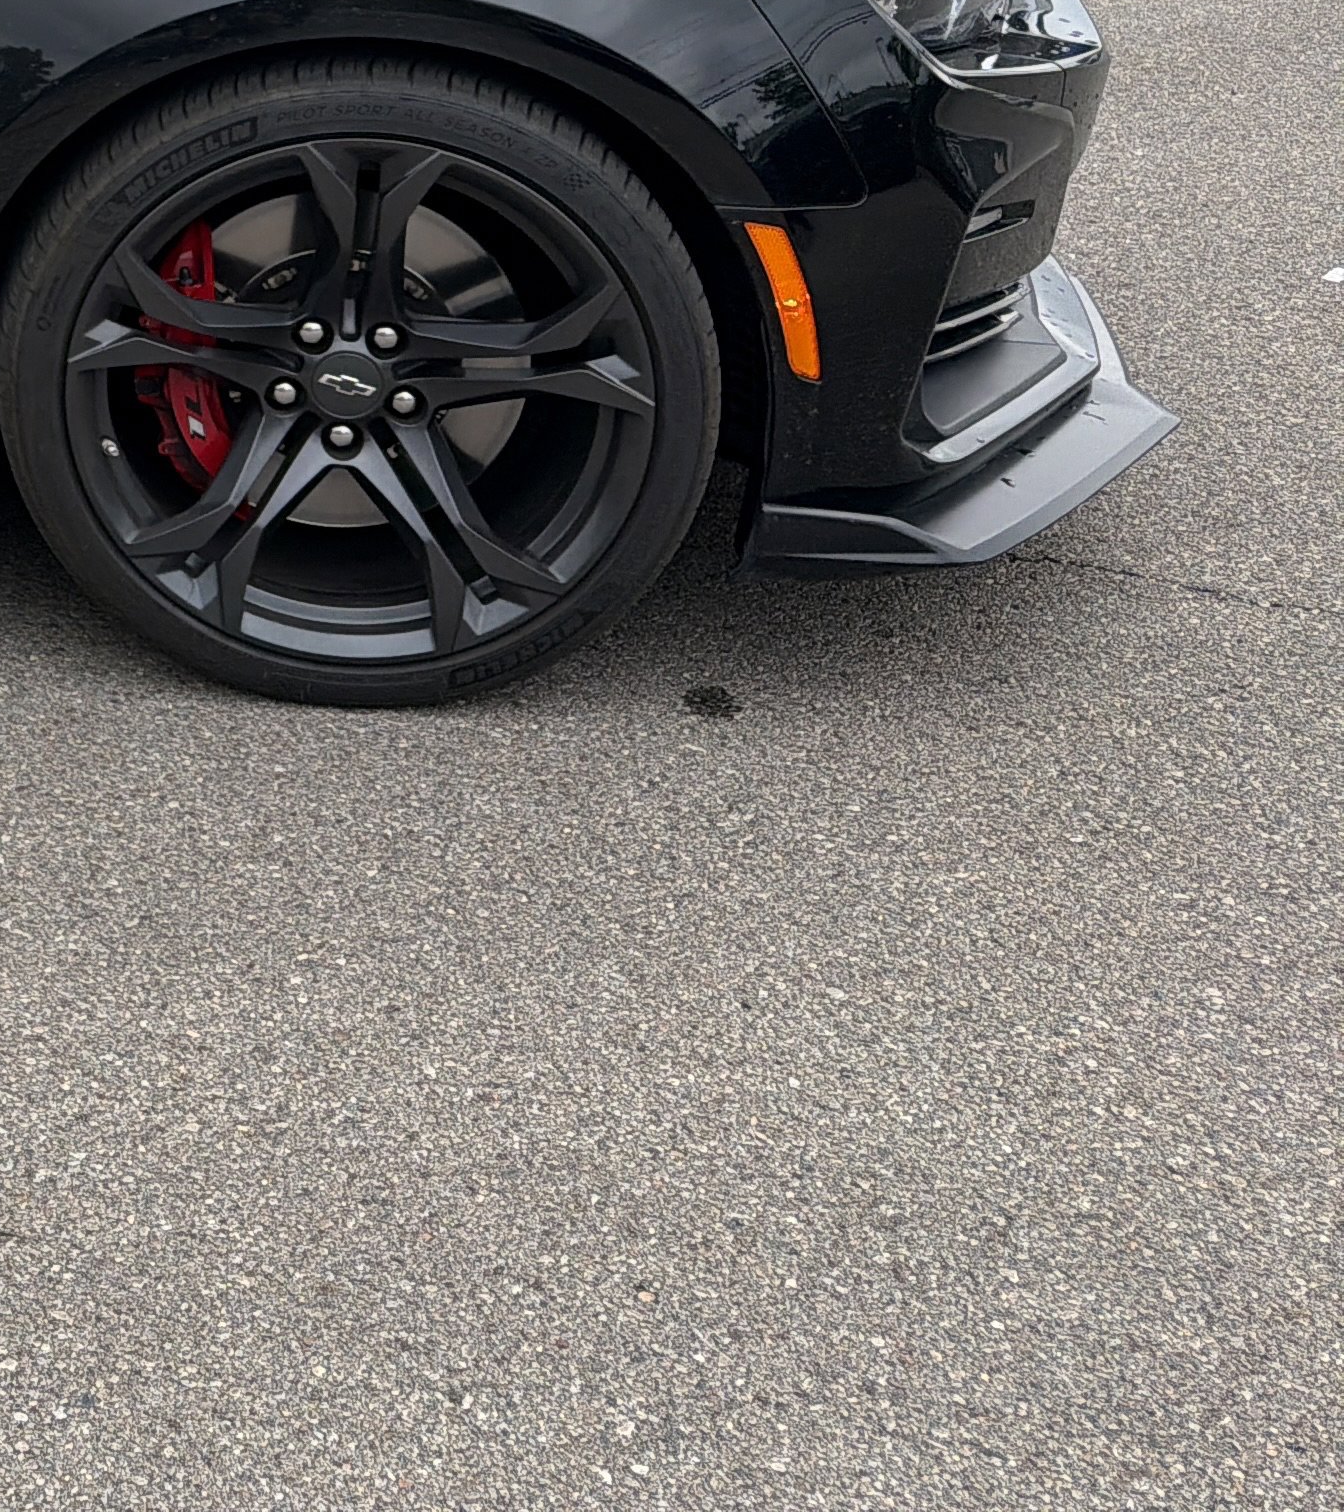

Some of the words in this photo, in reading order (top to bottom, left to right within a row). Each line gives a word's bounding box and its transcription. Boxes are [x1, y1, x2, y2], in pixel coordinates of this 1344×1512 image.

[277, 105, 327, 123] PILOT
[332, 103, 397, 117] SPORT
[403, 108, 434, 124] ALL
[443, 116, 516, 149] SEASON
[122, 119, 254, 203] MICHELIN
